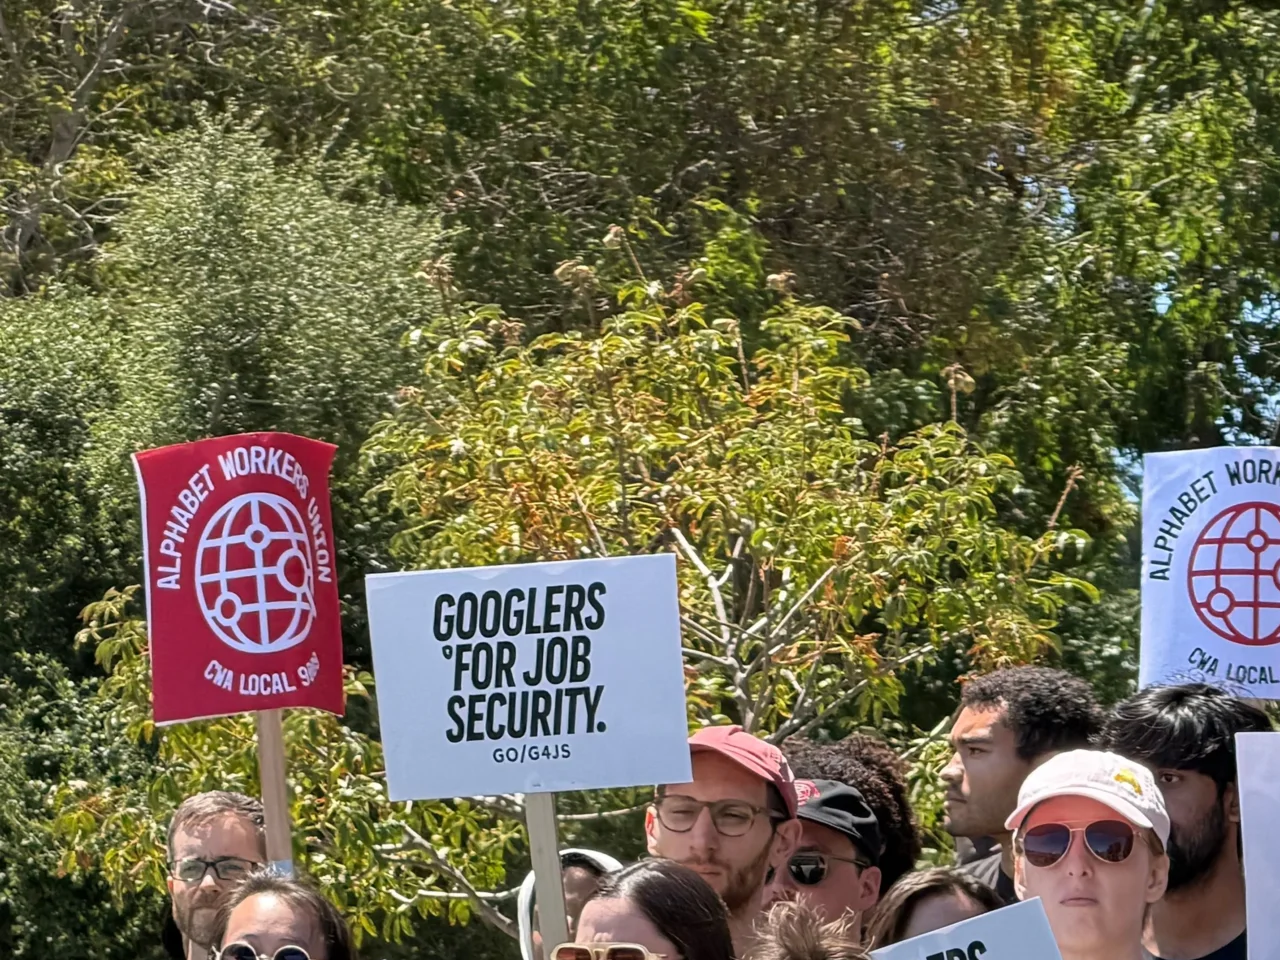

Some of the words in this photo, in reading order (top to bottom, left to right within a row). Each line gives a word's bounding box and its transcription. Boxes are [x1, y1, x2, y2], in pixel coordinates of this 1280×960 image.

[157, 464, 215, 589] ALPHABET
[217, 446, 309, 499] WORKERS
[308, 497, 332, 582] UNION
[1150, 471, 1218, 581] ALPHABET
[432, 582, 607, 641] GOOGLERS
[204, 660, 233, 691] CWA
[239, 672, 297, 695] LOCAL
[454, 641, 516, 692] FOR
[523, 635, 592, 686] JOB
[1188, 648, 1218, 676] CWA
[1226, 665, 1280, 684] LOCAL
[445, 685, 607, 743] SECURITY.
[492, 744, 571, 764] GO/G4JS
